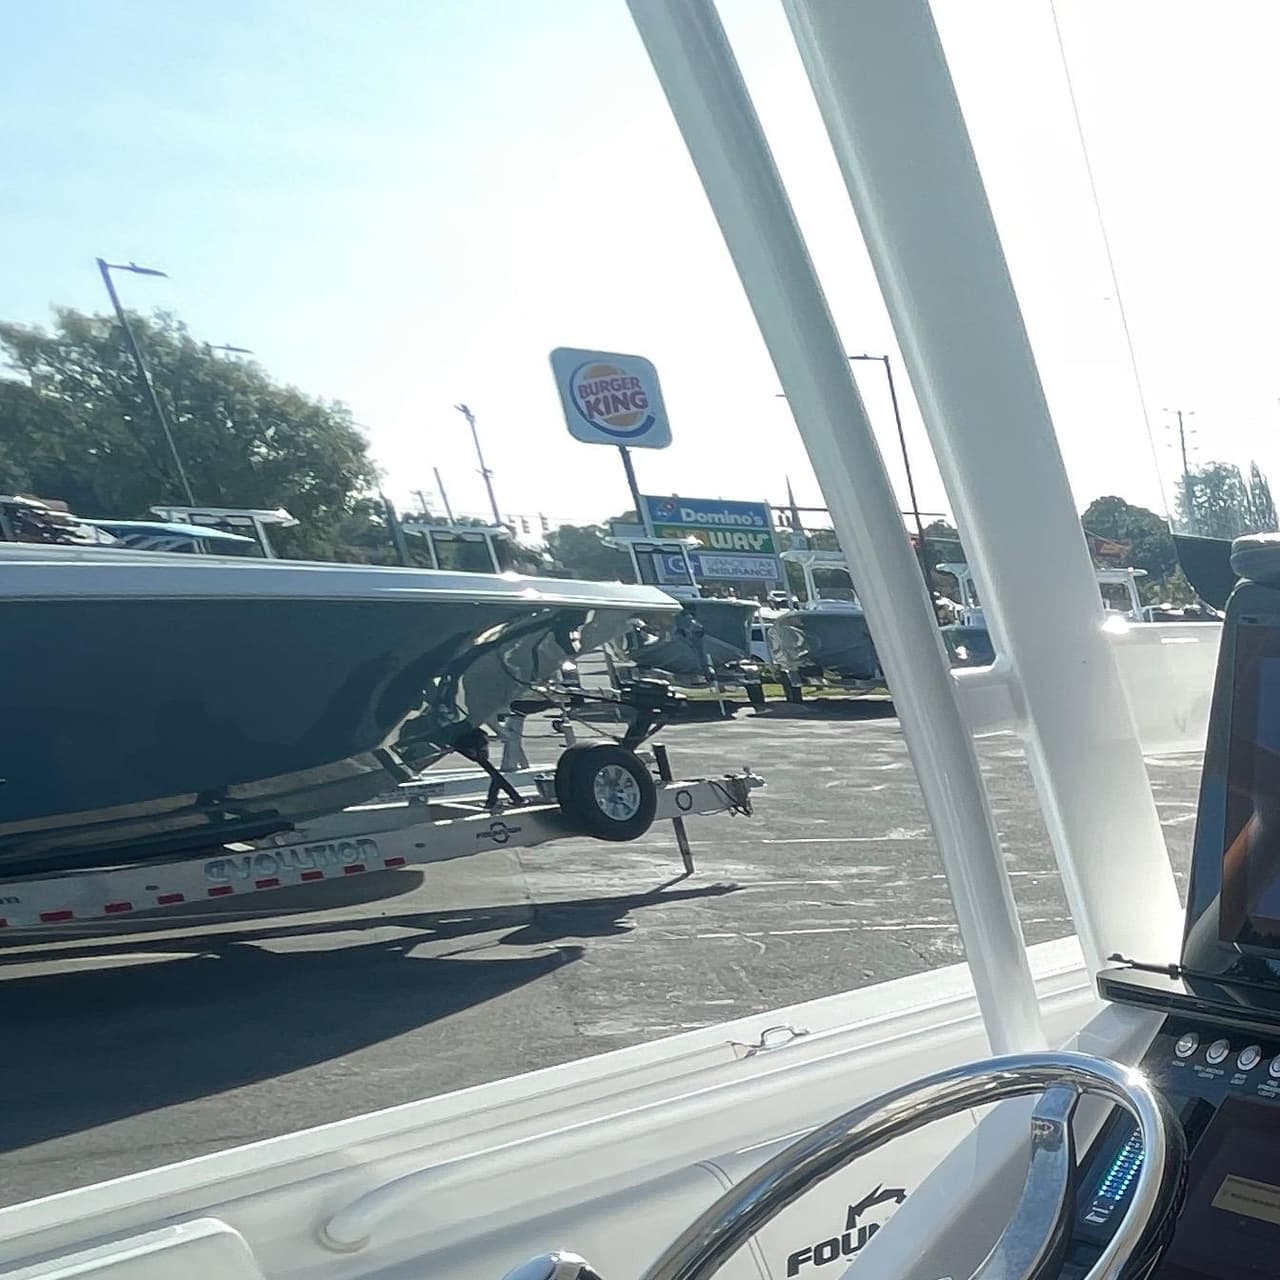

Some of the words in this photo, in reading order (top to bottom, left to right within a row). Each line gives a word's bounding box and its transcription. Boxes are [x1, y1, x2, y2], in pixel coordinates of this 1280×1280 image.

[578, 376, 642, 399] BURGER
[584, 390, 648, 419] KING
[680, 508, 764, 526] Domino's
